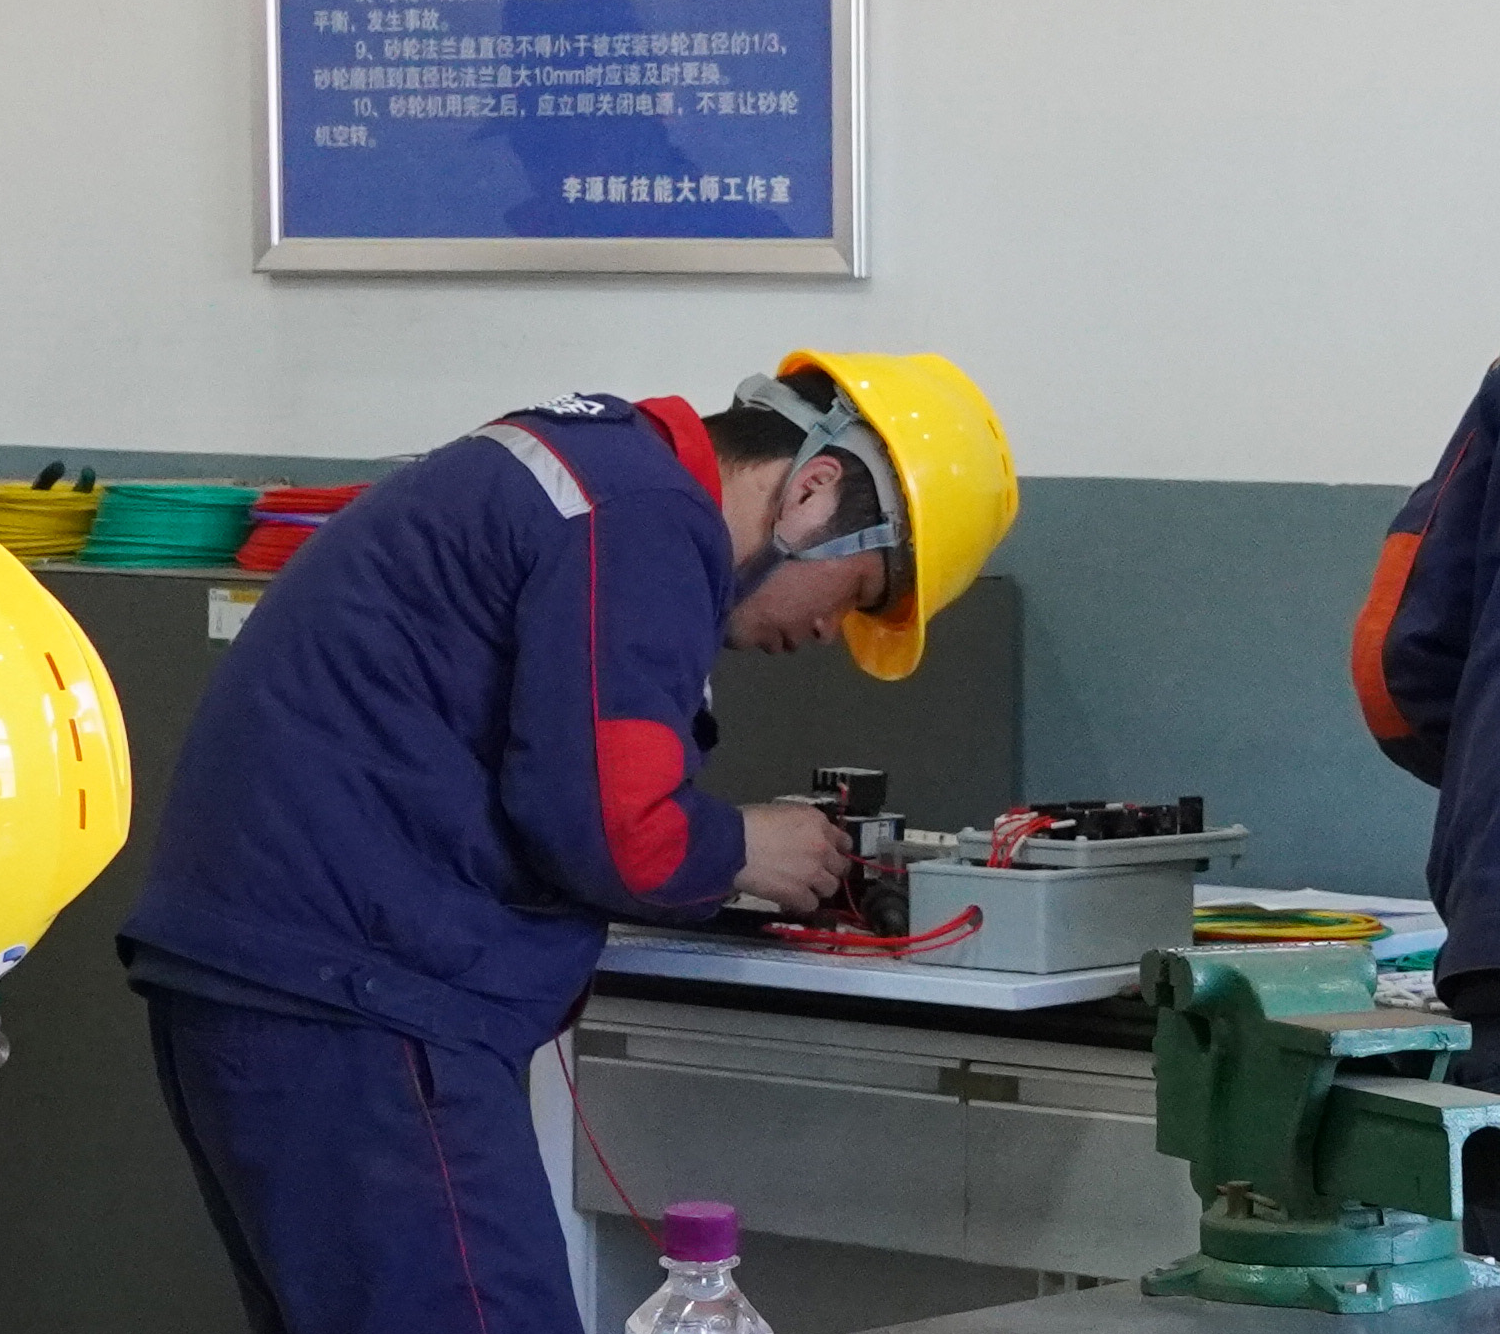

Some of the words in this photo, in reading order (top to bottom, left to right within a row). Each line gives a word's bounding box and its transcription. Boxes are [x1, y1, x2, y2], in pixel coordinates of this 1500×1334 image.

[563, 175, 790, 203] 李源新技能大师工作室
